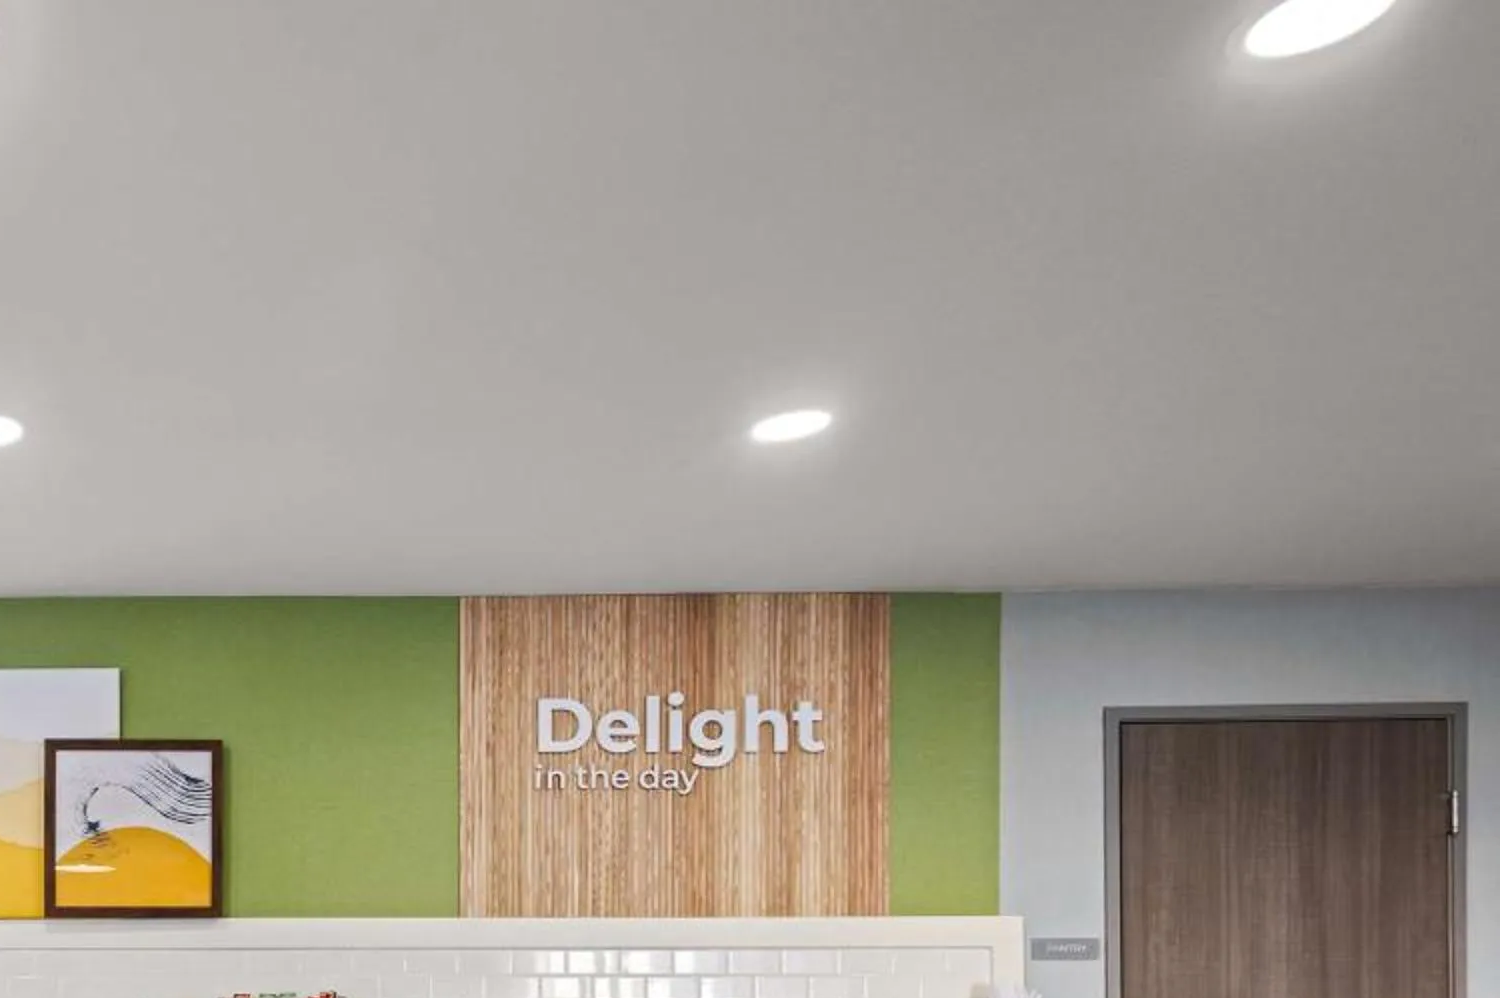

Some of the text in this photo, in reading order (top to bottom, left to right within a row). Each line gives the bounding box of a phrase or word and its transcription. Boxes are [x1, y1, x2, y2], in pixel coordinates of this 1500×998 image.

[537, 692, 825, 767] Delight
[535, 764, 699, 795] in the day
